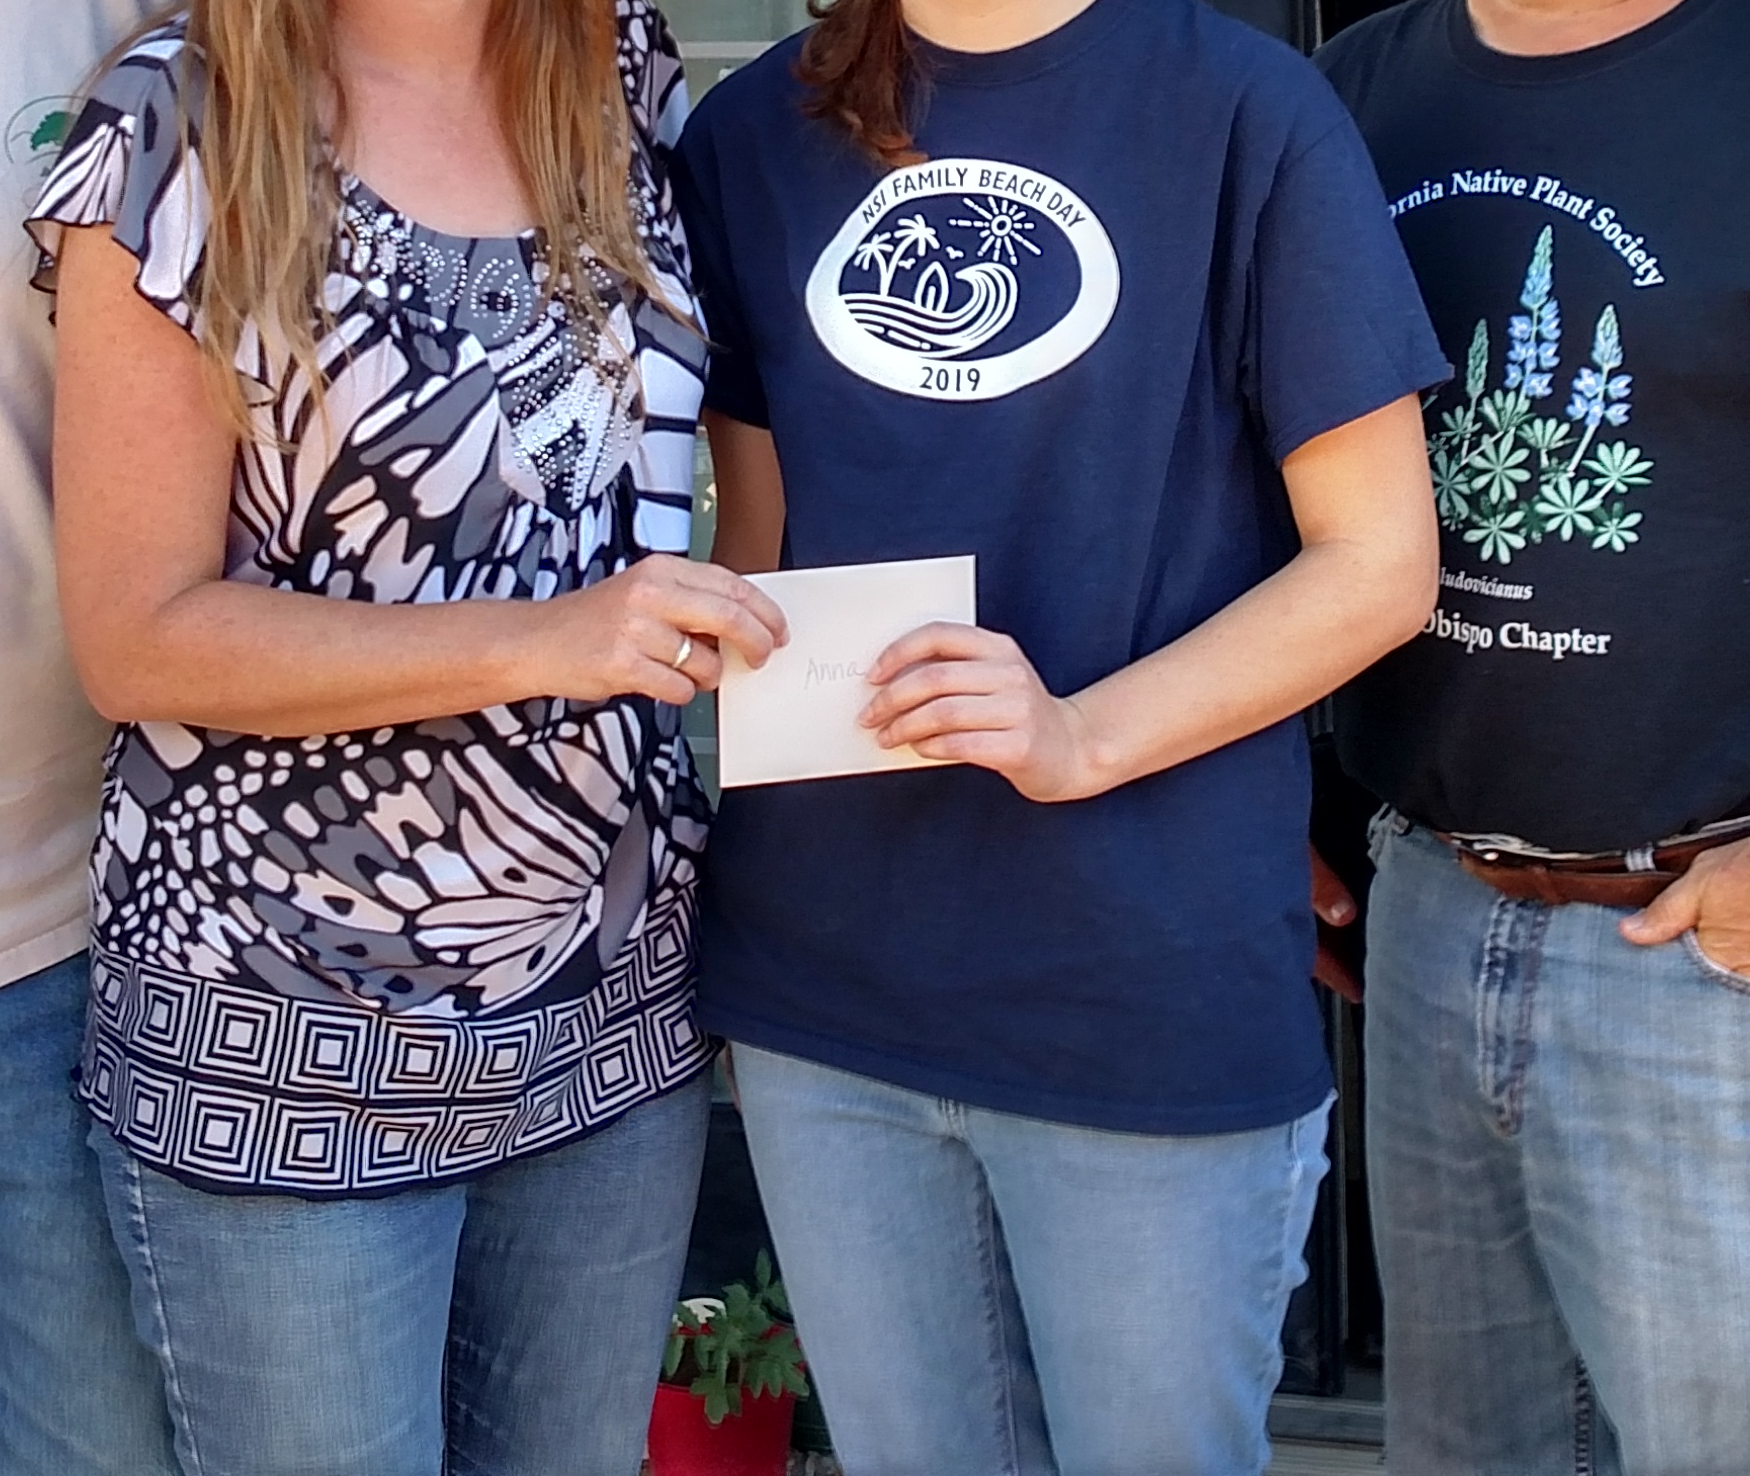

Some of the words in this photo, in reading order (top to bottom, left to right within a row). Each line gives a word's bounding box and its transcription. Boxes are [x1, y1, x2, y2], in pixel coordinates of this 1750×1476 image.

[861, 188, 888, 224] NSI
[892, 167, 969, 199] FAMILY
[978, 168, 1047, 203] BEACH
[1045, 191, 1087, 228] DAY
[1450, 169, 1527, 196] Native
[1529, 176, 1594, 221] Plant
[1590, 207, 1666, 288] Society
[919, 366, 982, 392] 2019
[1500, 622, 1612, 660] Chapter
